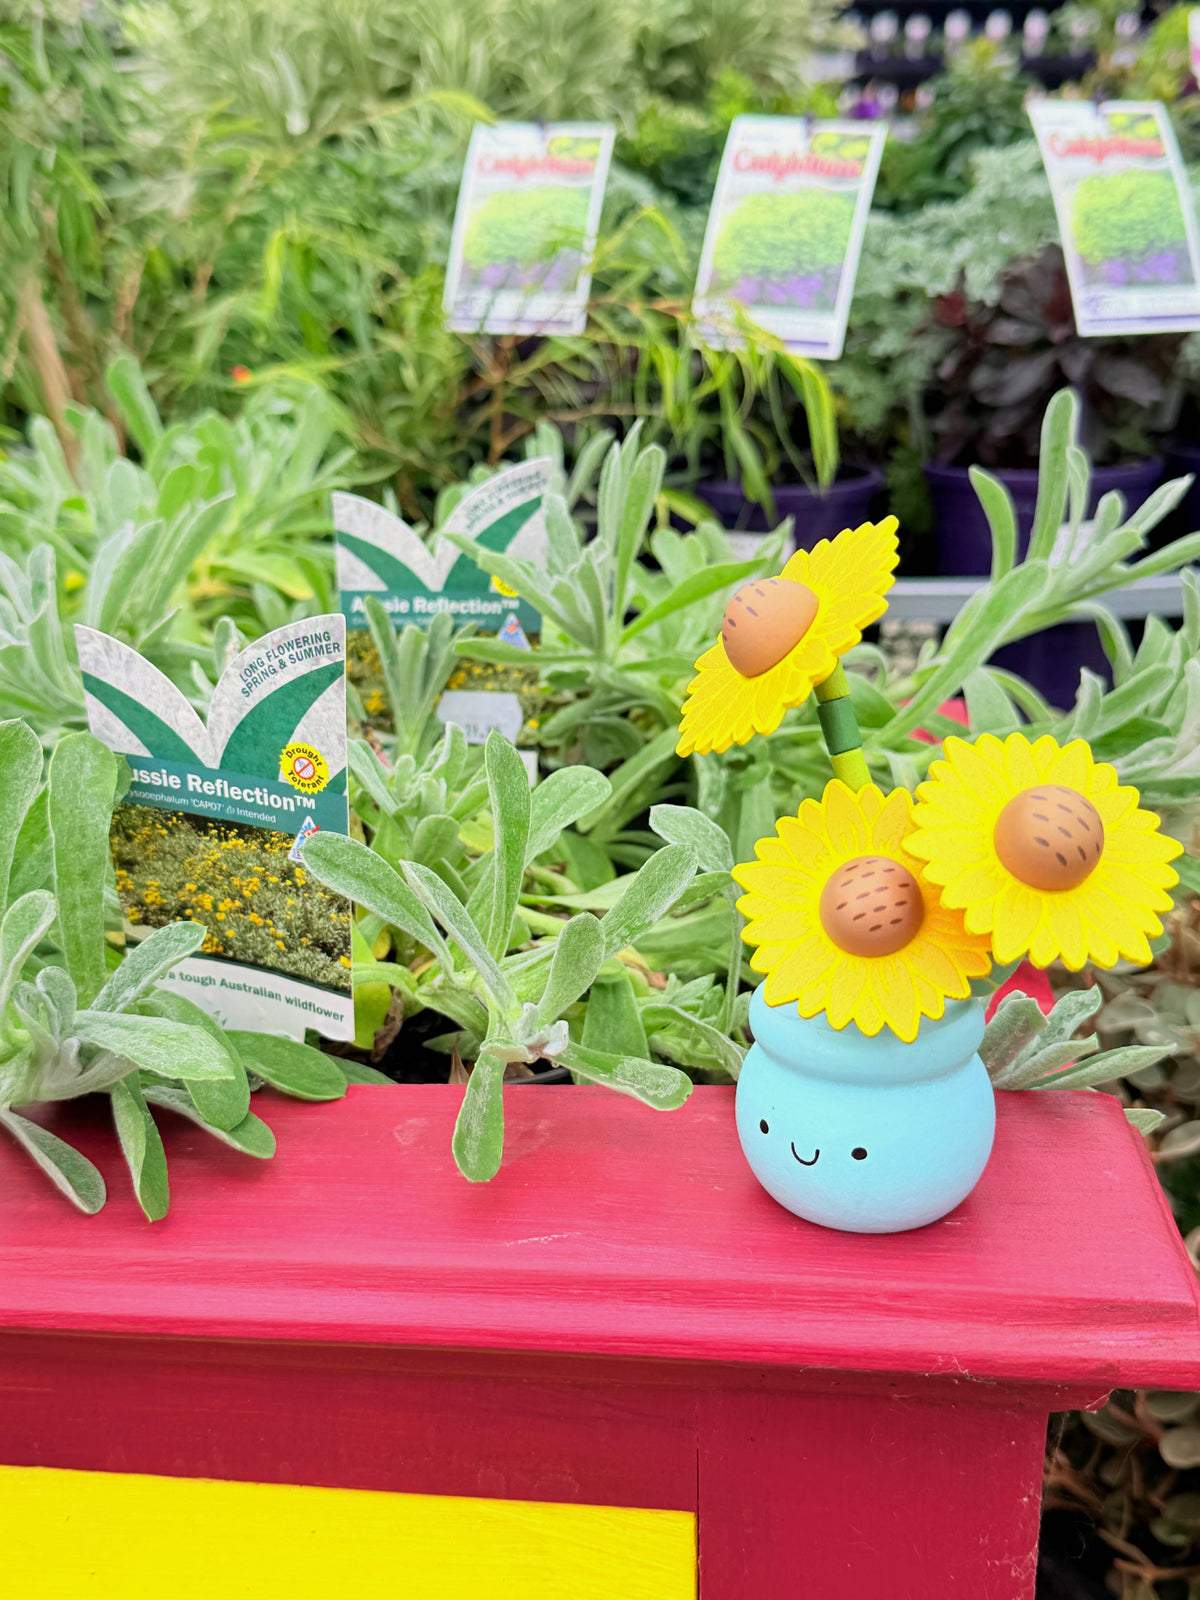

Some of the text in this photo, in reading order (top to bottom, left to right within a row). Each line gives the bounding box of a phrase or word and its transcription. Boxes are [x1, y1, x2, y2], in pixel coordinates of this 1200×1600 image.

[352, 596, 410, 614] Asie
[239, 631, 331, 683] LONG FLOWERING
[241, 642, 341, 697] SPRING & SUMMER
[285, 747, 322, 766] Drought
[131, 768, 182, 789] ussie
[288, 770, 324, 789] Tolerant
[129, 790, 189, 806] ysocephalum
[236, 807, 277, 823] Intended
[168, 971, 345, 1022] a tough Australian wildflower
